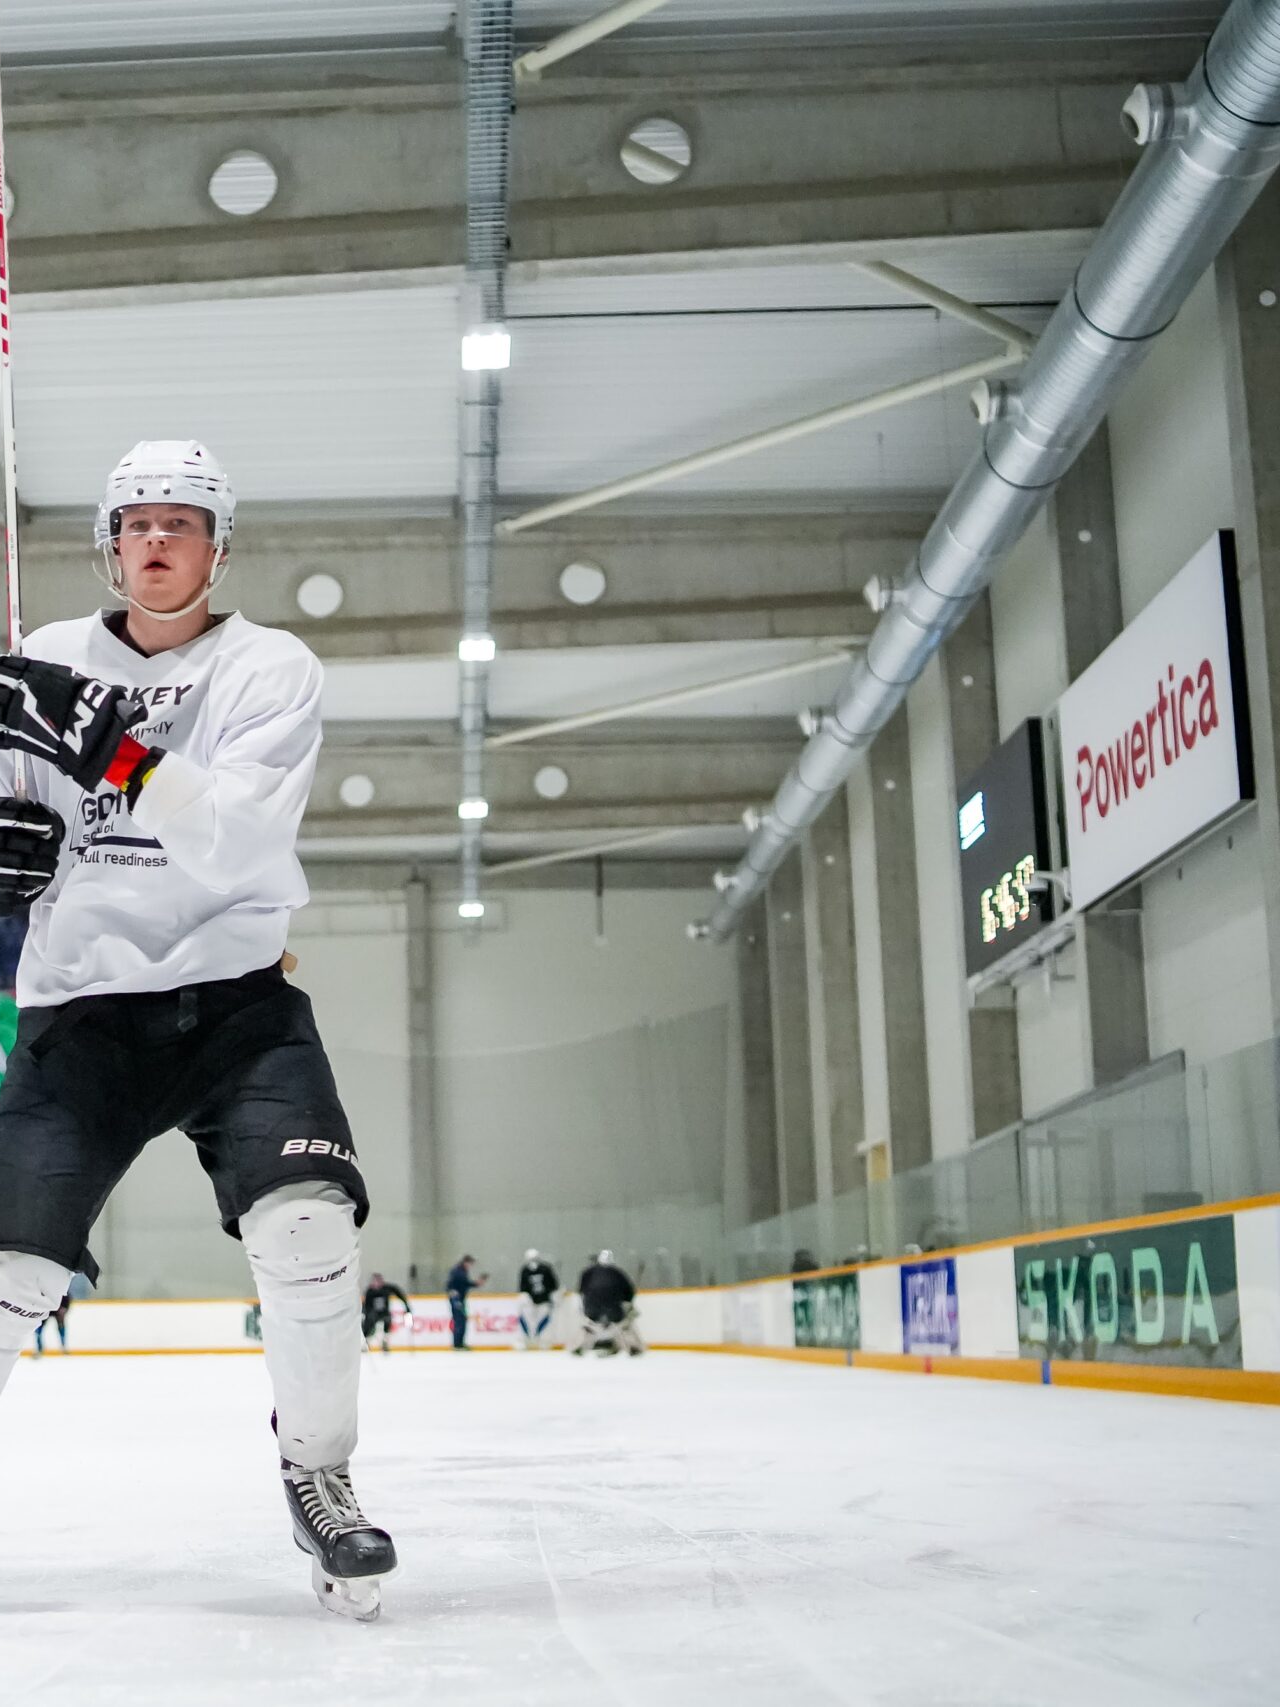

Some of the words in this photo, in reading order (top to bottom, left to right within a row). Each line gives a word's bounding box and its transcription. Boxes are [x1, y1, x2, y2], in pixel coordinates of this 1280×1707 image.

[124, 684, 193, 707] KEY
[1077, 658, 1219, 833] Powertica
[104, 853, 168, 867] readiness
